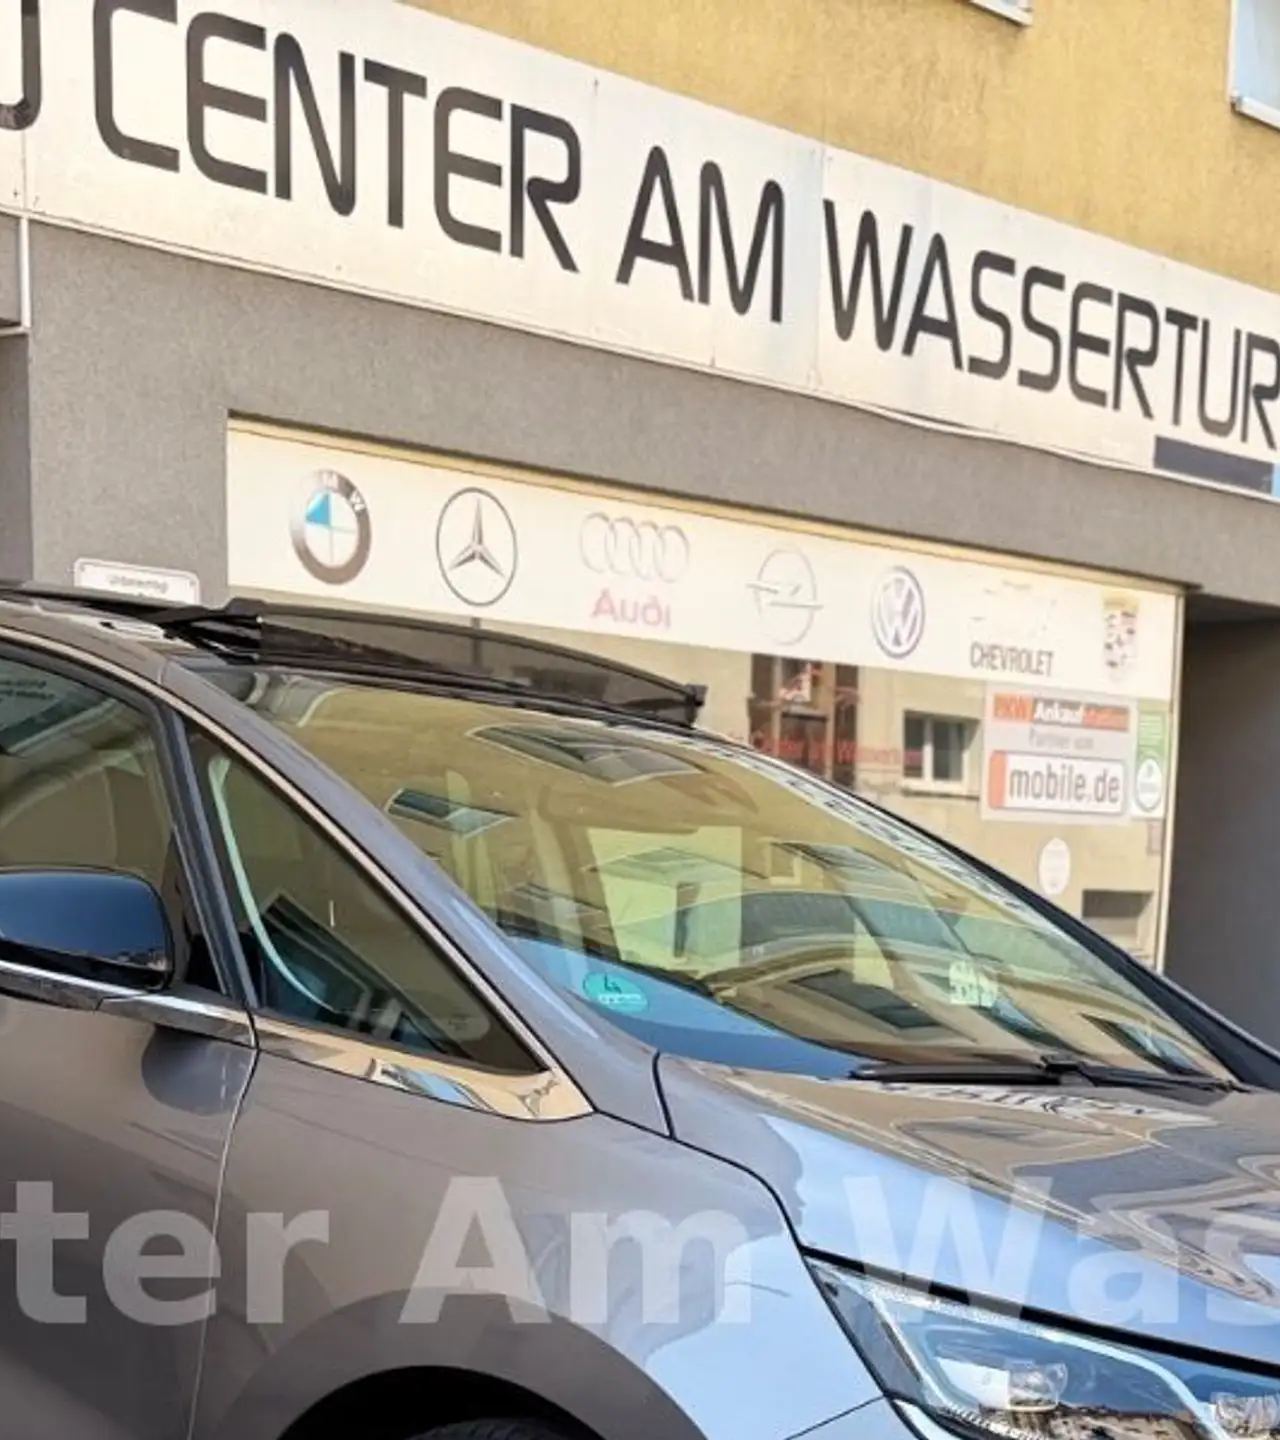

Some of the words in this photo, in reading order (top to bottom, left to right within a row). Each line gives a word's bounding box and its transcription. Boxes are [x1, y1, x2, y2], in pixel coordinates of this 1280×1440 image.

[93, 0, 579, 272] CENTER
[615, 145, 786, 324] AM
[590, 587, 672, 630] Audi
[969, 640, 1055, 678] CHEVROLET
[1009, 763, 1120, 804] mobile.de
